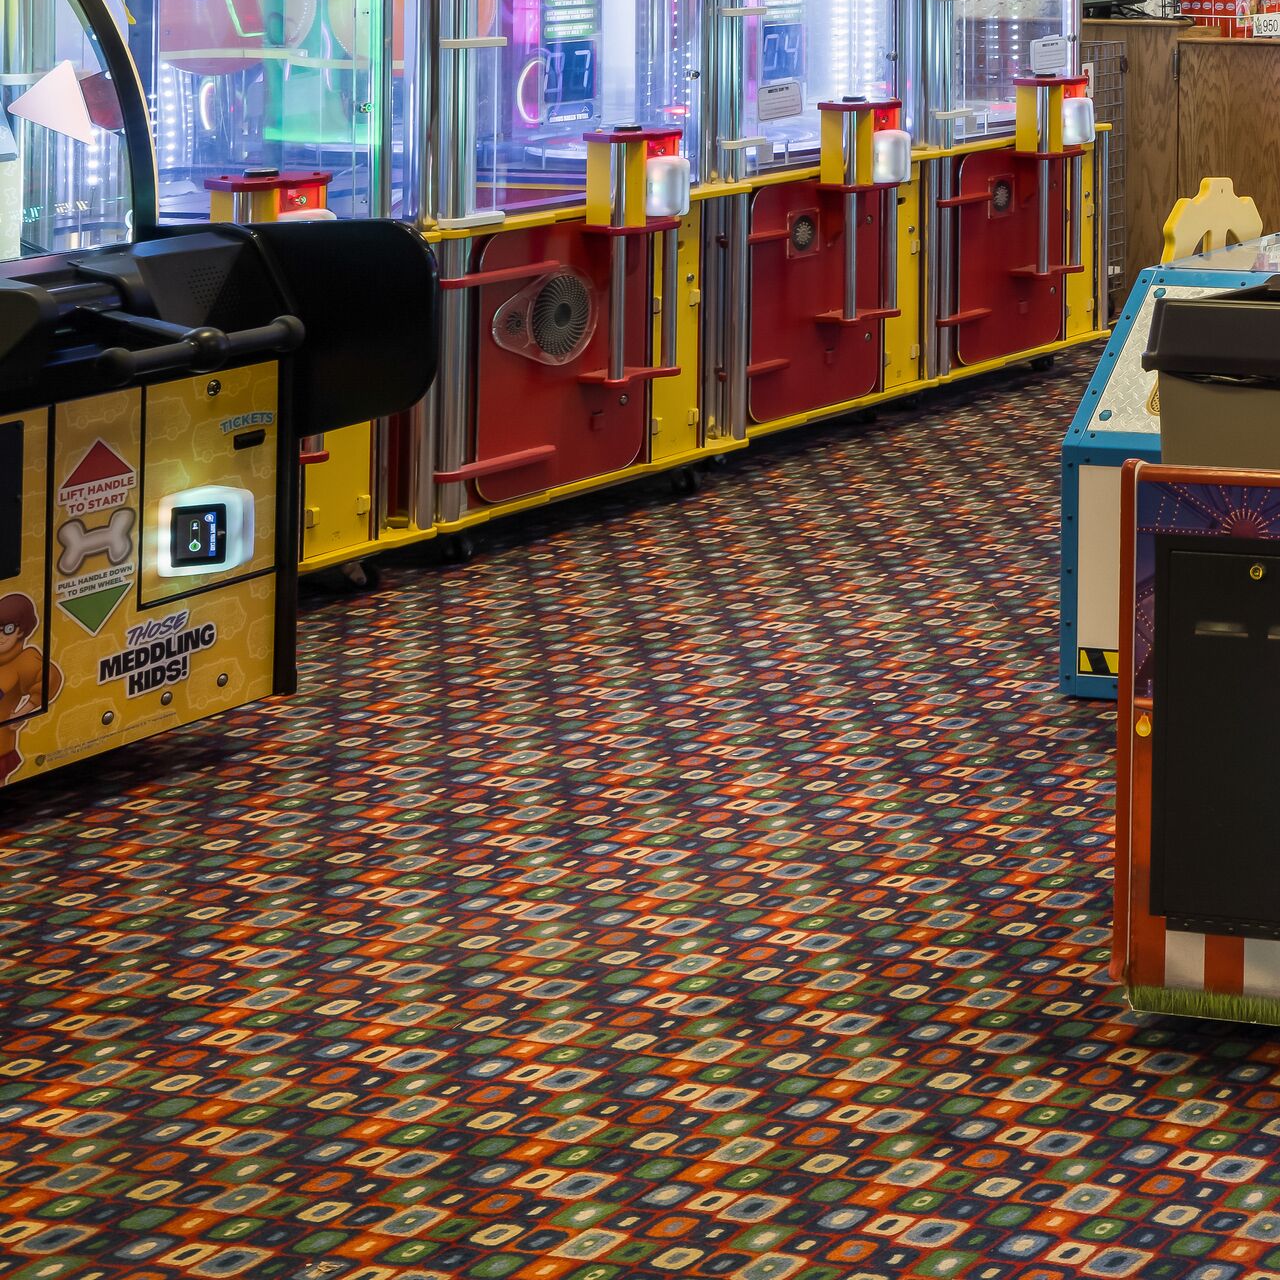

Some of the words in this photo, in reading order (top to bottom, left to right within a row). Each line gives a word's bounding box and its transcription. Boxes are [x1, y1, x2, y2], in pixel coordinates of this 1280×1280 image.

[1262, 18, 1279, 33] 950
[220, 411, 274, 433] TICKETS
[60, 488, 84, 504] LIFT
[87, 476, 134, 496] HANDLE
[68, 502, 84, 514] TO
[86, 492, 126, 510] START
[58, 581, 77, 591] PULL
[78, 572, 110, 587] HANDLE
[111, 565, 133, 578] DOWN
[67, 589, 77, 598] TO
[78, 583, 94, 595] SPIN
[95, 577, 123, 591] WHEEL
[126, 610, 188, 647] THOSE
[99, 623, 215, 683] MEDDLING
[127, 656, 188, 696] KIDS!
